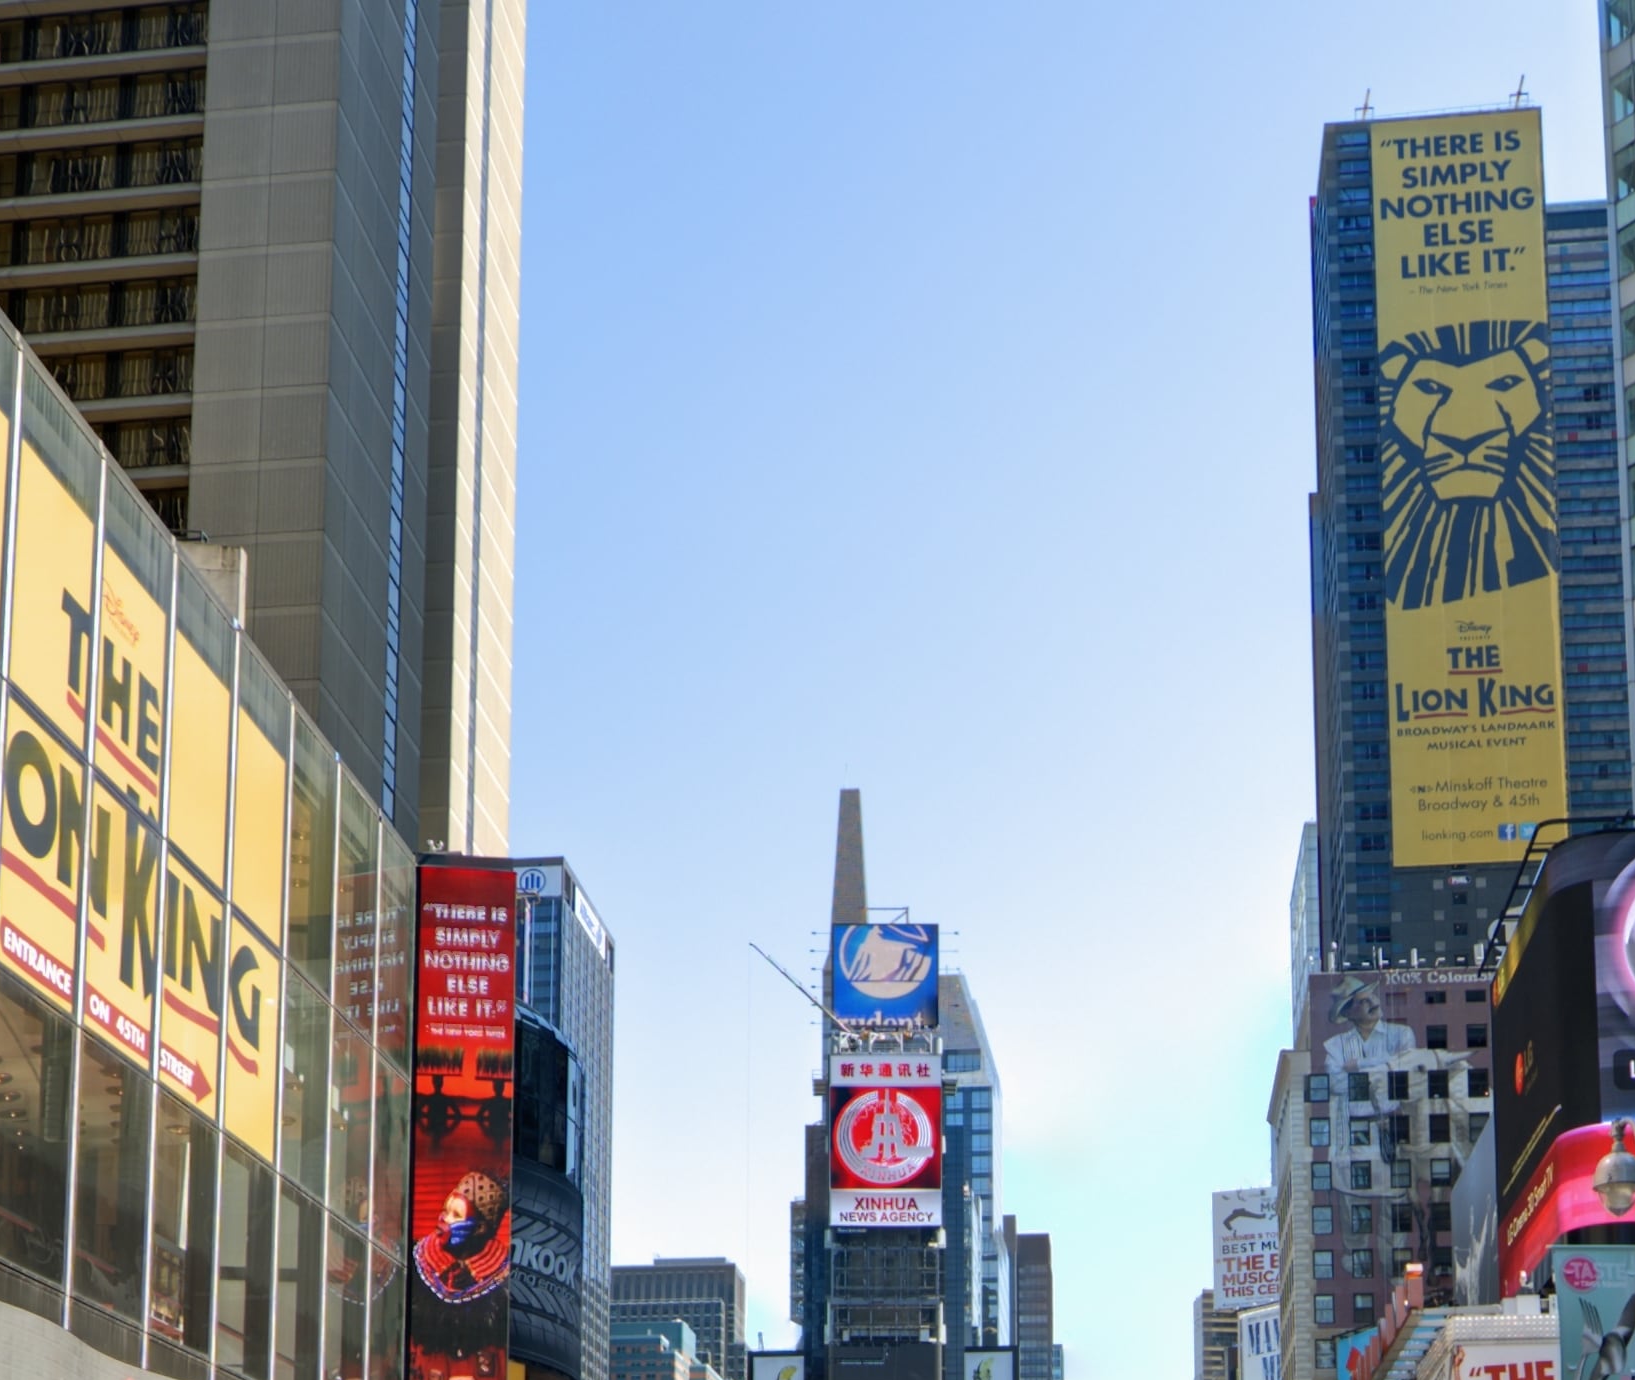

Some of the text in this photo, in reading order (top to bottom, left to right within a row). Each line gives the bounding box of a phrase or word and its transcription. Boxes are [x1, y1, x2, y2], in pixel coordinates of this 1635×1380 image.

[1495, 131, 1521, 153] IS
[1402, 159, 1512, 189] SIMPLY
[1380, 187, 1534, 220] NOTHING
[1423, 220, 1494, 248] ELSE
[1401, 252, 1470, 280] LIKE
[1447, 644, 1501, 669] THE
[61, 586, 163, 777] THE
[1396, 677, 1555, 722] LION KING
[1397, 720, 1556, 737] BROADWAY'S LANDMARK
[1427, 736, 1527, 750] MUSICAL EVENT
[1435, 776, 1548, 793] Minskoff Theatre
[1418, 796, 1487, 813] Broadway
[1509, 795, 1540, 807] 45th
[1421, 826, 1493, 842] lionking.com
[120, 783, 261, 1052] KING
[435, 926, 501, 949] SIMPLY
[424, 949, 510, 972] NOTHING
[446, 973, 489, 995] ELSE
[3, 926, 195, 1087] ENTRANCE ON 45TH STREET
[427, 995, 468, 1017] LIKE
[840, 1062, 932, 1079] 新华通讯社
[854, 1197, 919, 1211] XINHUA
[839, 1211, 934, 1222] NEWS AGENCY
